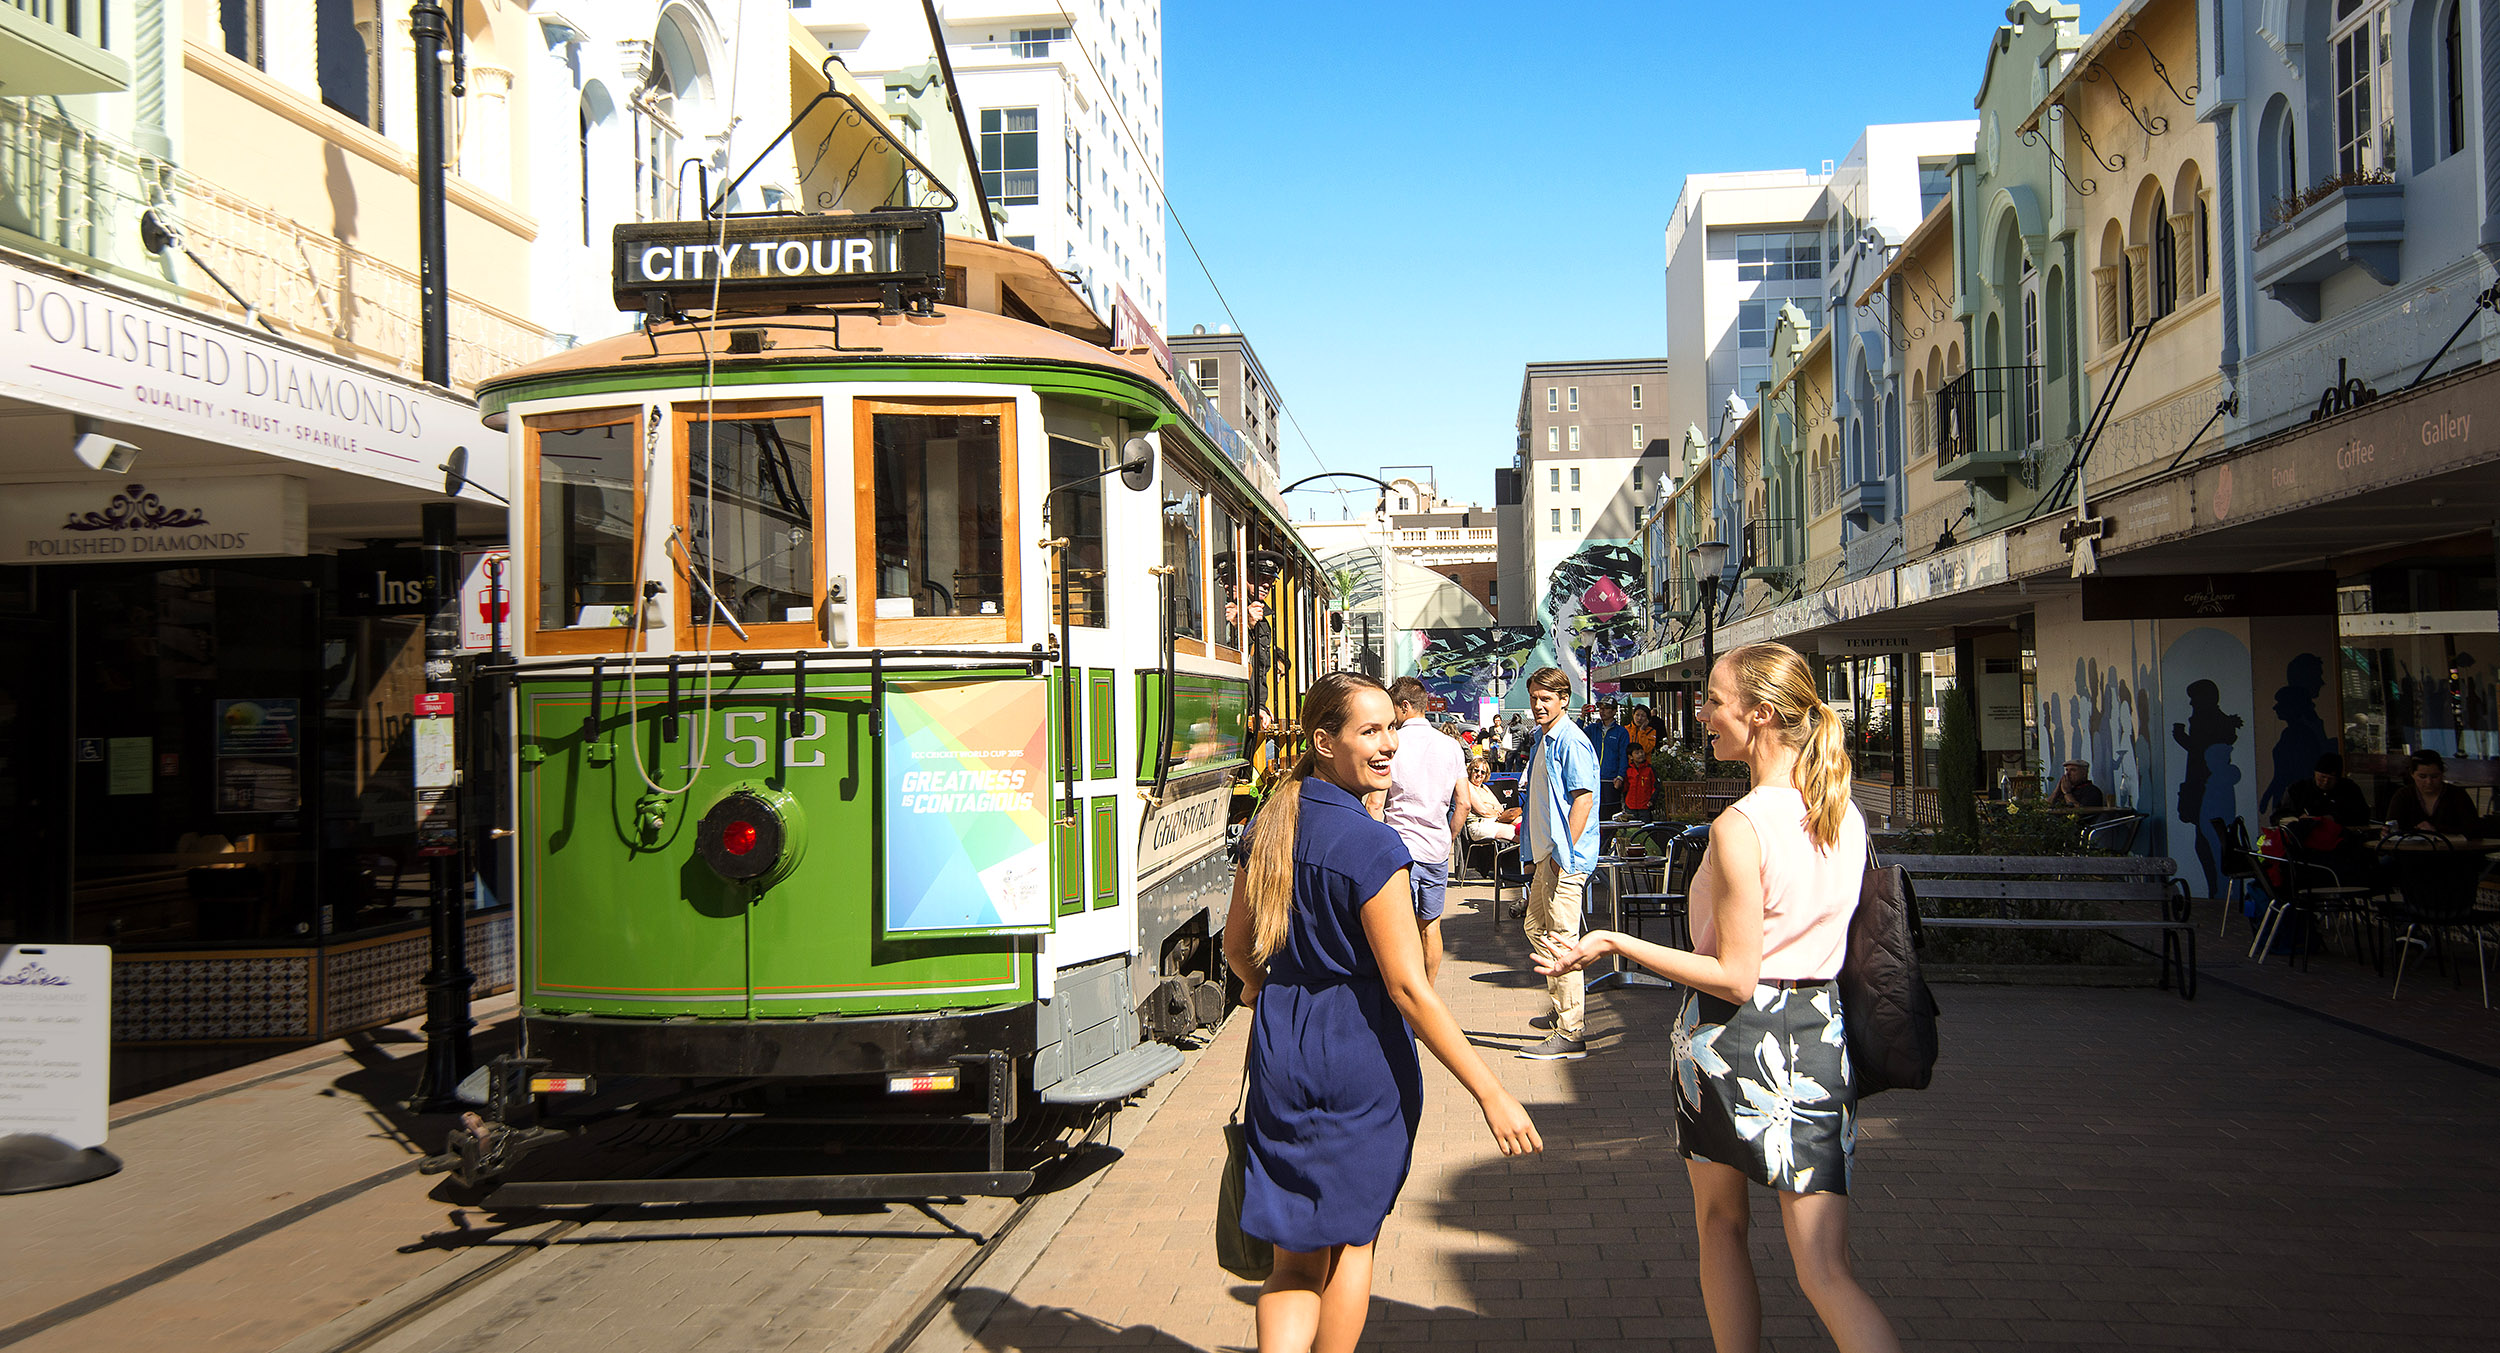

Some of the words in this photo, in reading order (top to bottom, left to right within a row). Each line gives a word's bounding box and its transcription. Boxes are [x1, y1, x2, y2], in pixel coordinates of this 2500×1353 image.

[641, 244, 742, 282] CITY
[750, 238, 874, 277] TOUR
[12, 280, 231, 386] POLISHED
[243, 350, 422, 439] DIAMONDS
[135, 385, 214, 418] QUALITY
[231, 409, 280, 434] TRUST
[296, 425, 358, 453] SPARKLE
[2271, 464, 2295, 488] Food
[2337, 440, 2374, 470] Coffee
[2422, 414, 2471, 446] Gallery
[28, 537, 126, 557] POLISHED
[133, 533, 247, 553] DIAMONDS
[376, 570, 424, 605] Ins
[1928, 562, 1941, 585] Eco
[2184, 592, 2208, 606] Coffee
[1844, 637, 1909, 647] TEMPTEUR
[679, 711, 826, 769] 152
[911, 751, 925, 759] ICC
[926, 751, 957, 759] CRICKET
[959, 750, 990, 759] WORLD
[990, 750, 1006, 758] CUP
[1007, 749, 1024, 757] 2015
[901, 769, 1027, 793] GREATNESS
[901, 794, 915, 807] IS
[913, 791, 1034, 814] CONTAGIOUS
[1153, 798, 1222, 851] CHRISTCHUR
